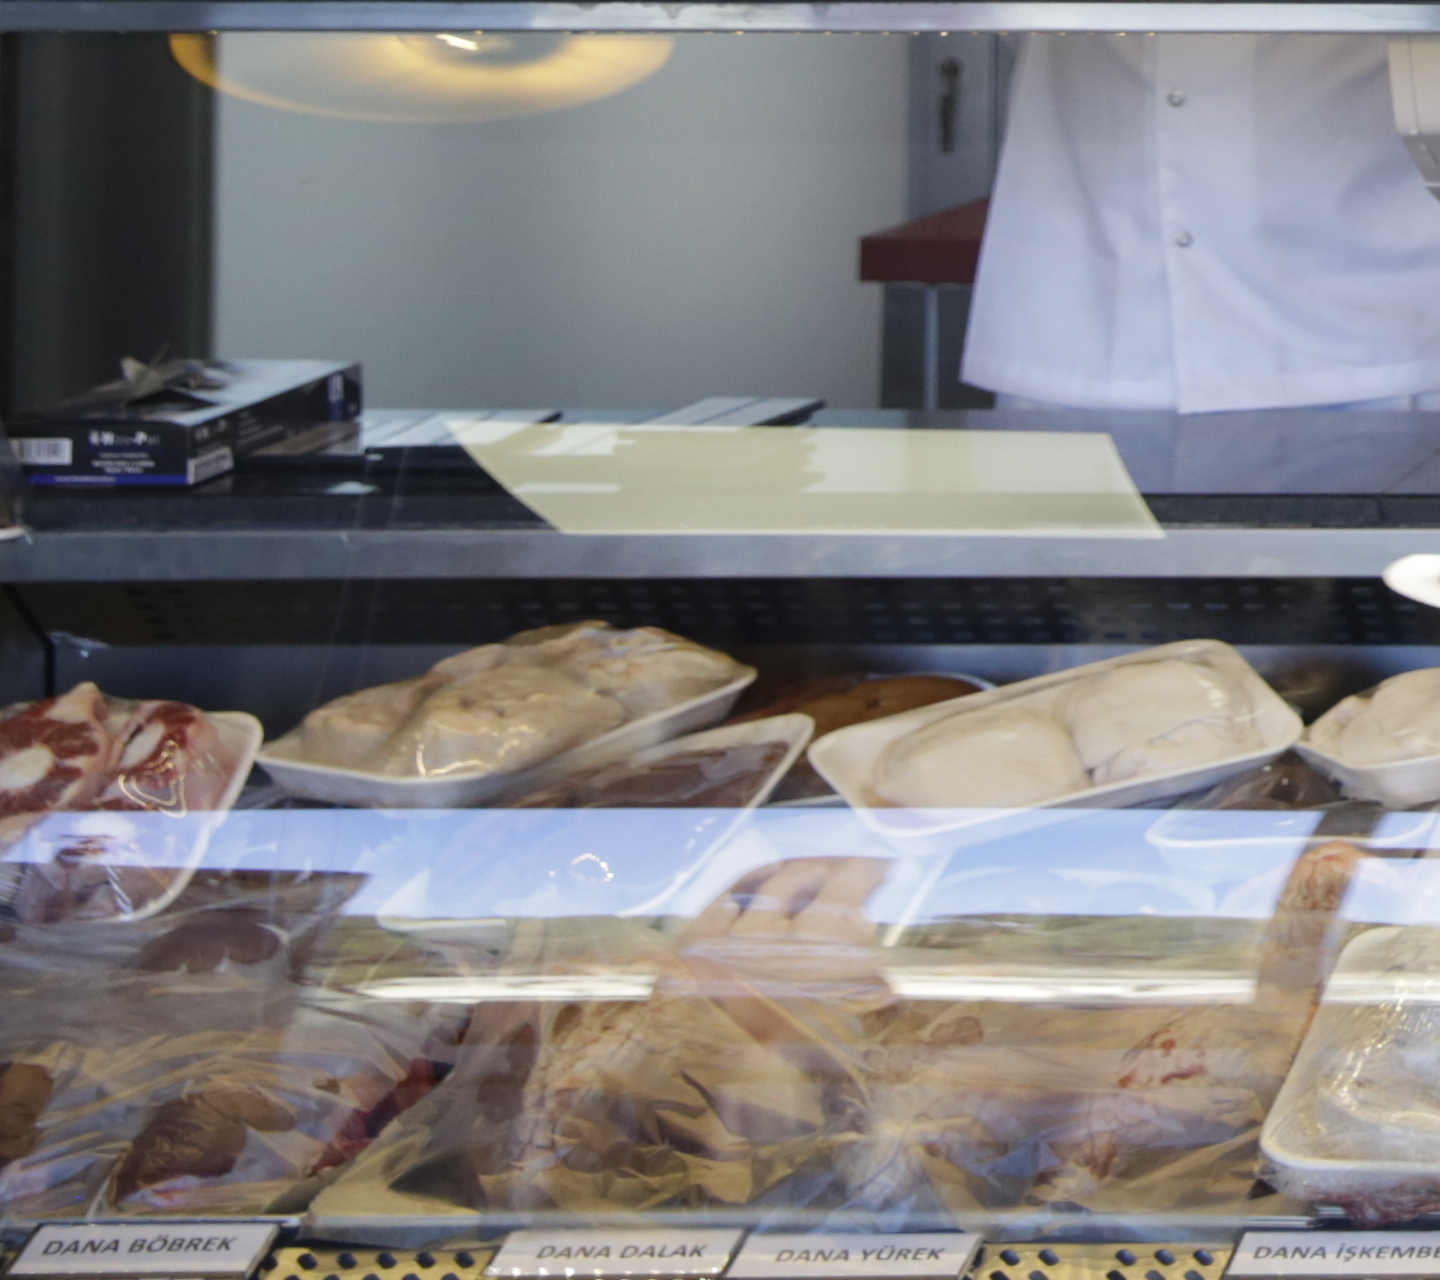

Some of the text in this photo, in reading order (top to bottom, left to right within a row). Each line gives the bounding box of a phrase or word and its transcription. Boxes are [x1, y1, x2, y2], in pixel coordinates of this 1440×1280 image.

[42, 1235, 238, 1255] DANA BÖBREK
[537, 1244, 708, 1260] DANA DALAK
[776, 1244, 945, 1263] DANA YÜREK
[1253, 1245, 1328, 1260] DANA
